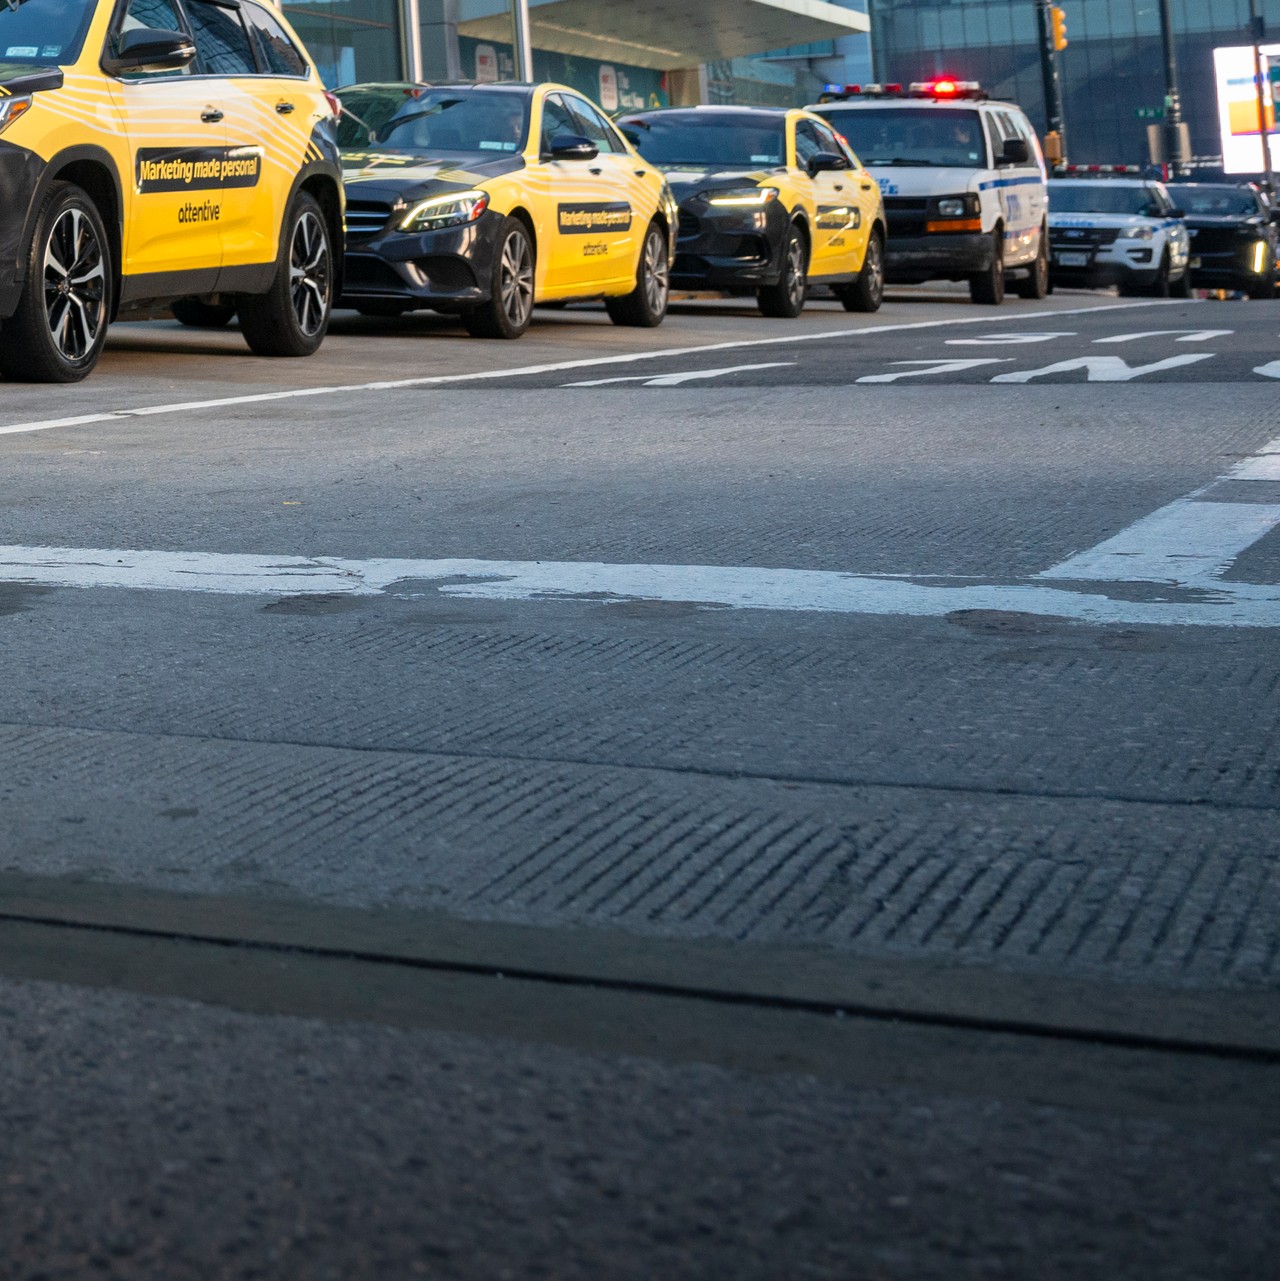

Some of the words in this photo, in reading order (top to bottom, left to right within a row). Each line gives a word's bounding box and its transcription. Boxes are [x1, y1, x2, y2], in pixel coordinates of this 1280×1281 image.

[140, 158, 193, 183] Marketing
[194, 158, 220, 178] made
[220, 157, 258, 181] personal
